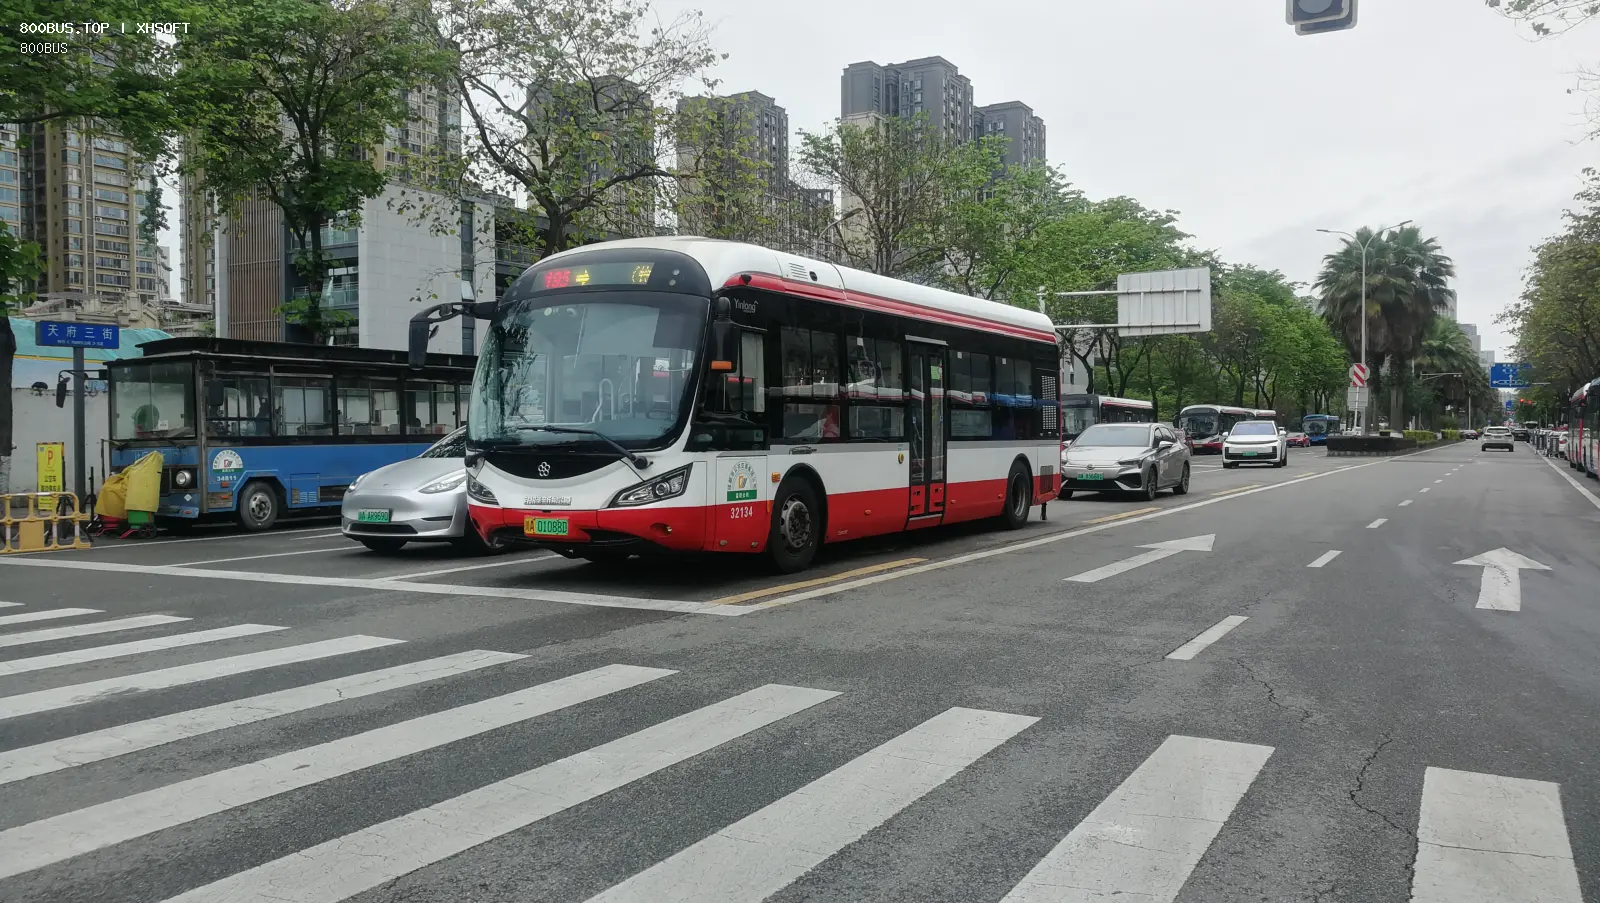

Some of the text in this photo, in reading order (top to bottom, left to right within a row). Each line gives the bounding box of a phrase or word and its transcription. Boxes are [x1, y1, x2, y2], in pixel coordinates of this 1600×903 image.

[734, 298, 756, 314] Yinlong
[47, 324, 113, 340] 天府三街
[730, 506, 753, 519] 32134
